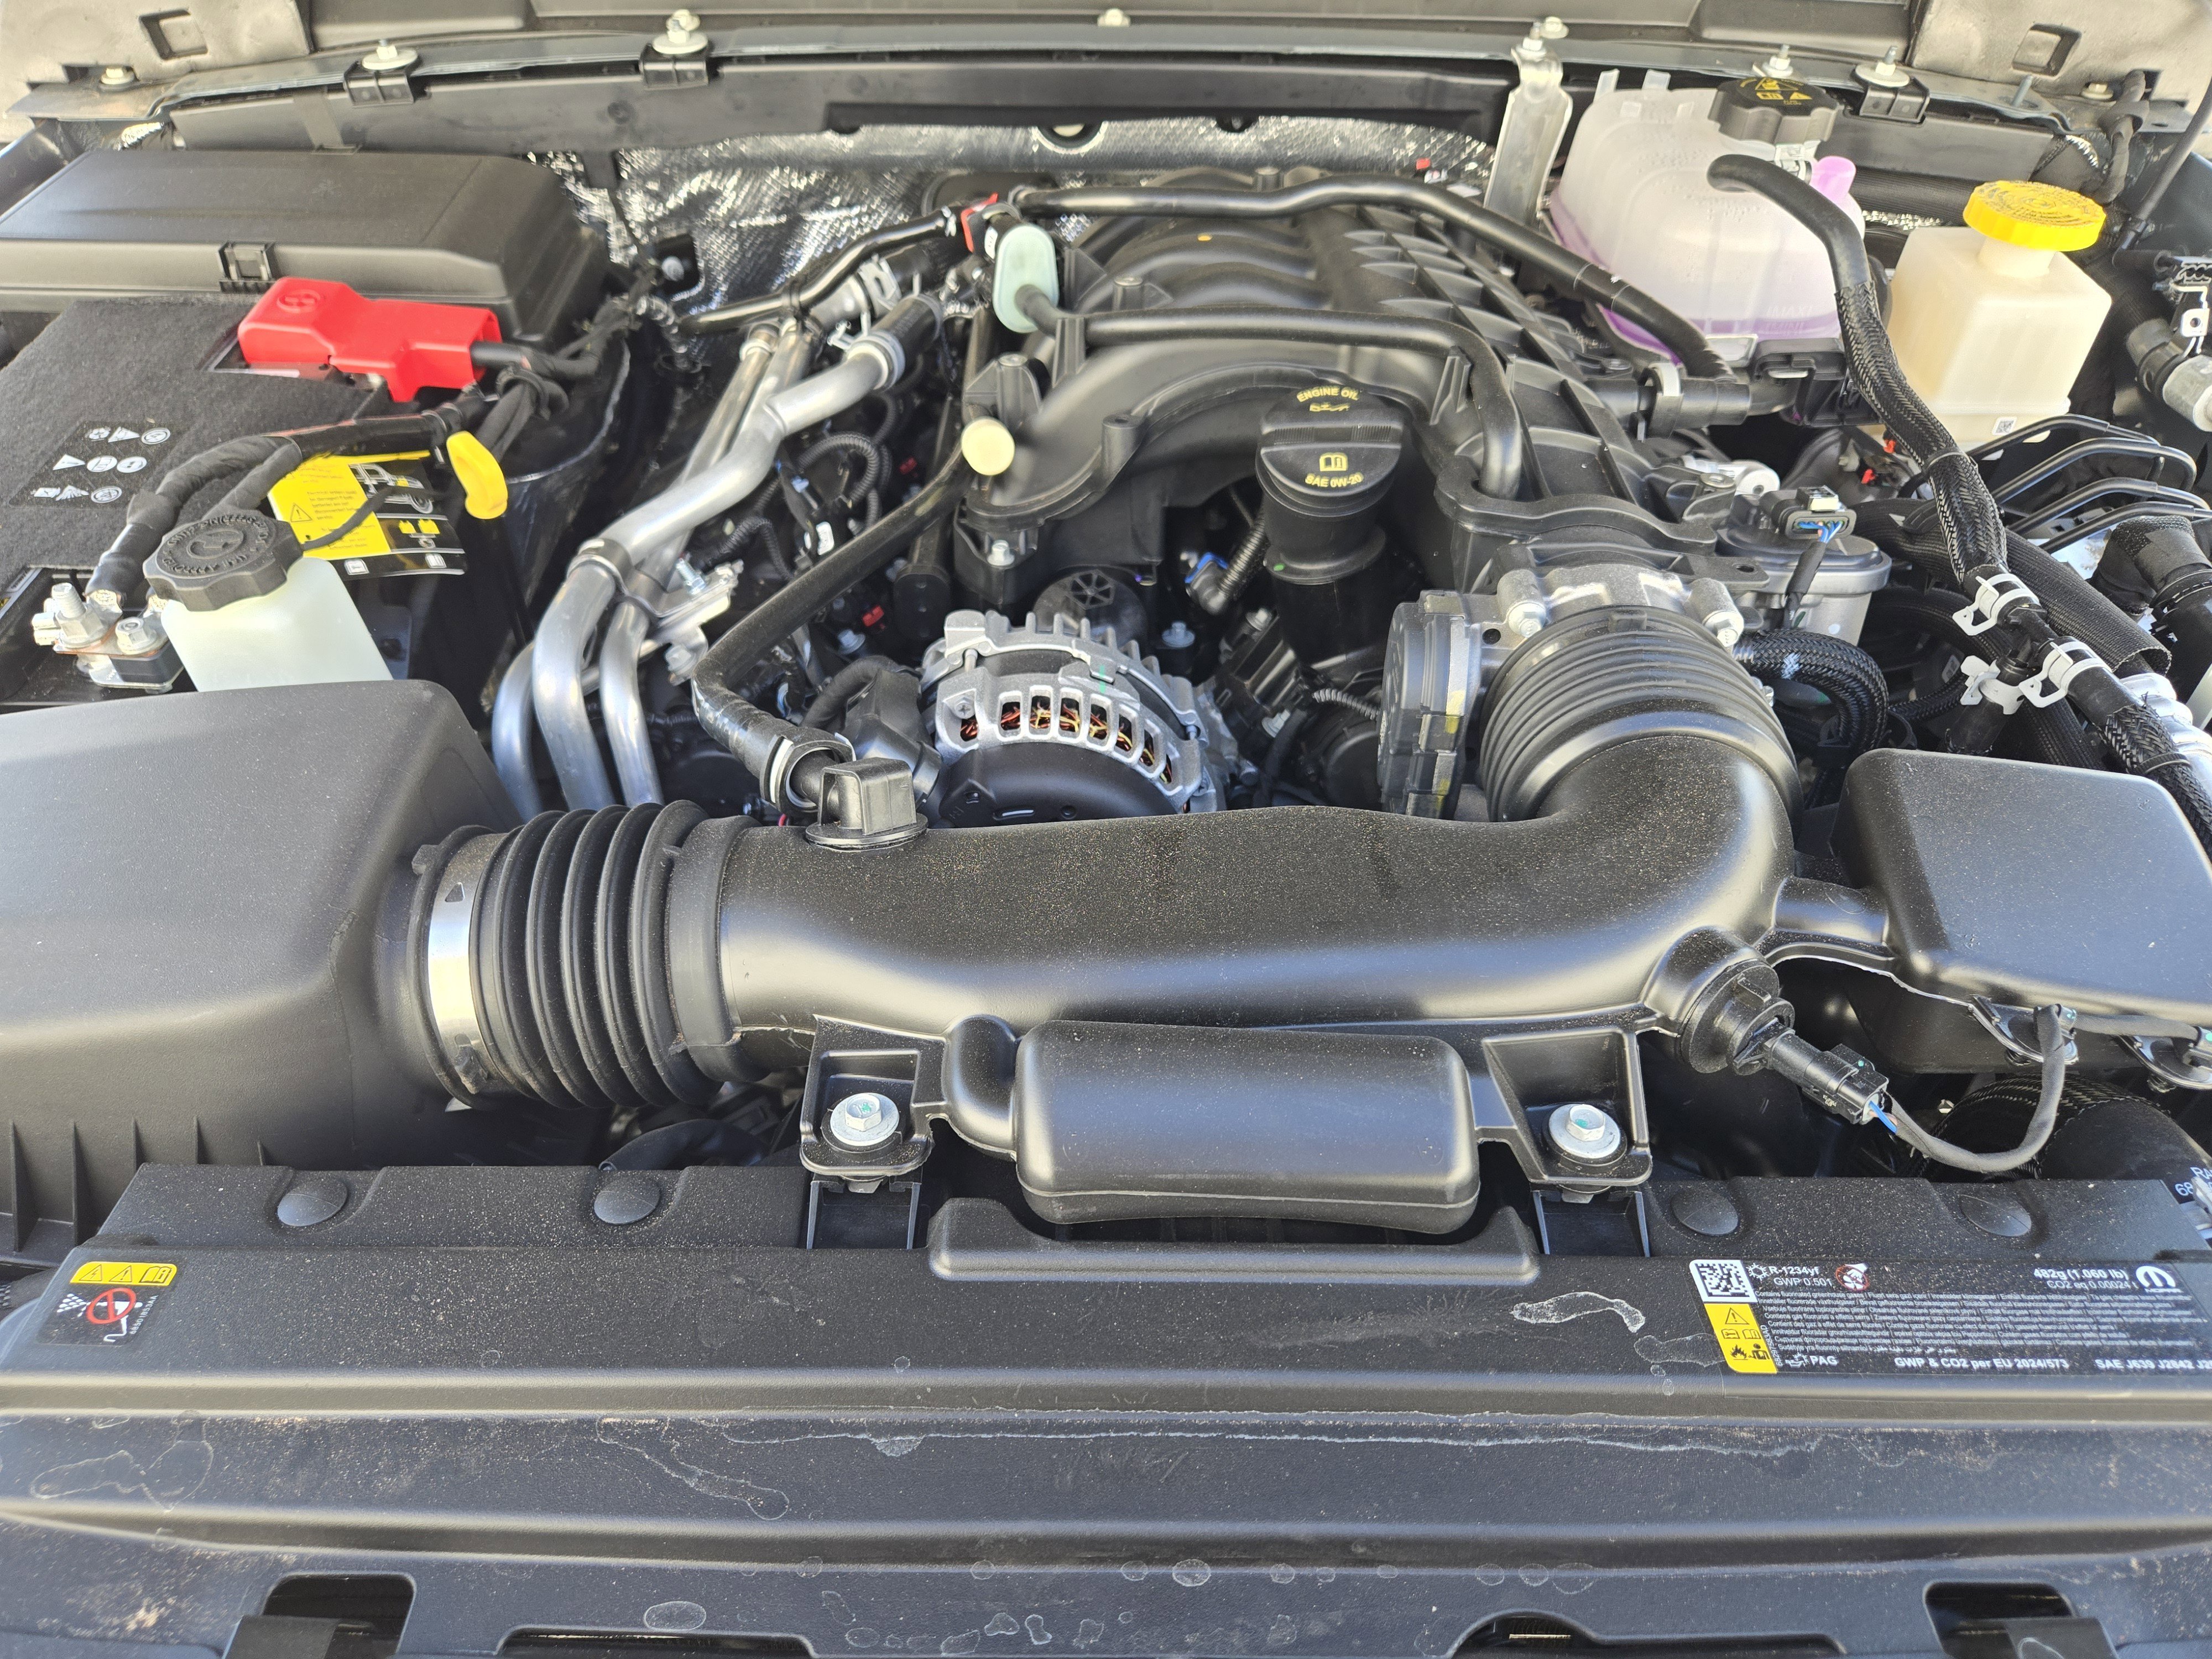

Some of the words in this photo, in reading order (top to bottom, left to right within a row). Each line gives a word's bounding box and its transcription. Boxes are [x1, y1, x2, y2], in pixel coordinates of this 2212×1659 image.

[1296, 387, 1339, 403] ENGINE
[1340, 387, 1360, 401] OIL
[1305, 473, 1329, 487] SAE
[1770, 1266, 1820, 1276] R-1234yf
[2033, 1269, 2068, 1280] 482g
[2068, 1269, 2107, 1280] (1.060
[2110, 1269, 2129, 1280] lb)
[1773, 1277, 1801, 1286] GWP
[1803, 1277, 1832, 1287] 0.501
[2047, 1280, 2073, 1289] CO2
[2074, 1282, 2089, 1291] eq
[2089, 1281, 2131, 1290] 0.00024
[1809, 1355, 1838, 1366] PAG
[1894, 1358, 1926, 1368] GWP
[1928, 1358, 1939, 1368] &
[1941, 1358, 1970, 1368] CO2
[1970, 1359, 1991, 1369] per
[1992, 1358, 2013, 1368] EU
[2013, 1358, 2070, 1369] 2024/573
[2094, 1359, 2125, 1369] SAE
[2126, 1359, 2156, 1369] J639
